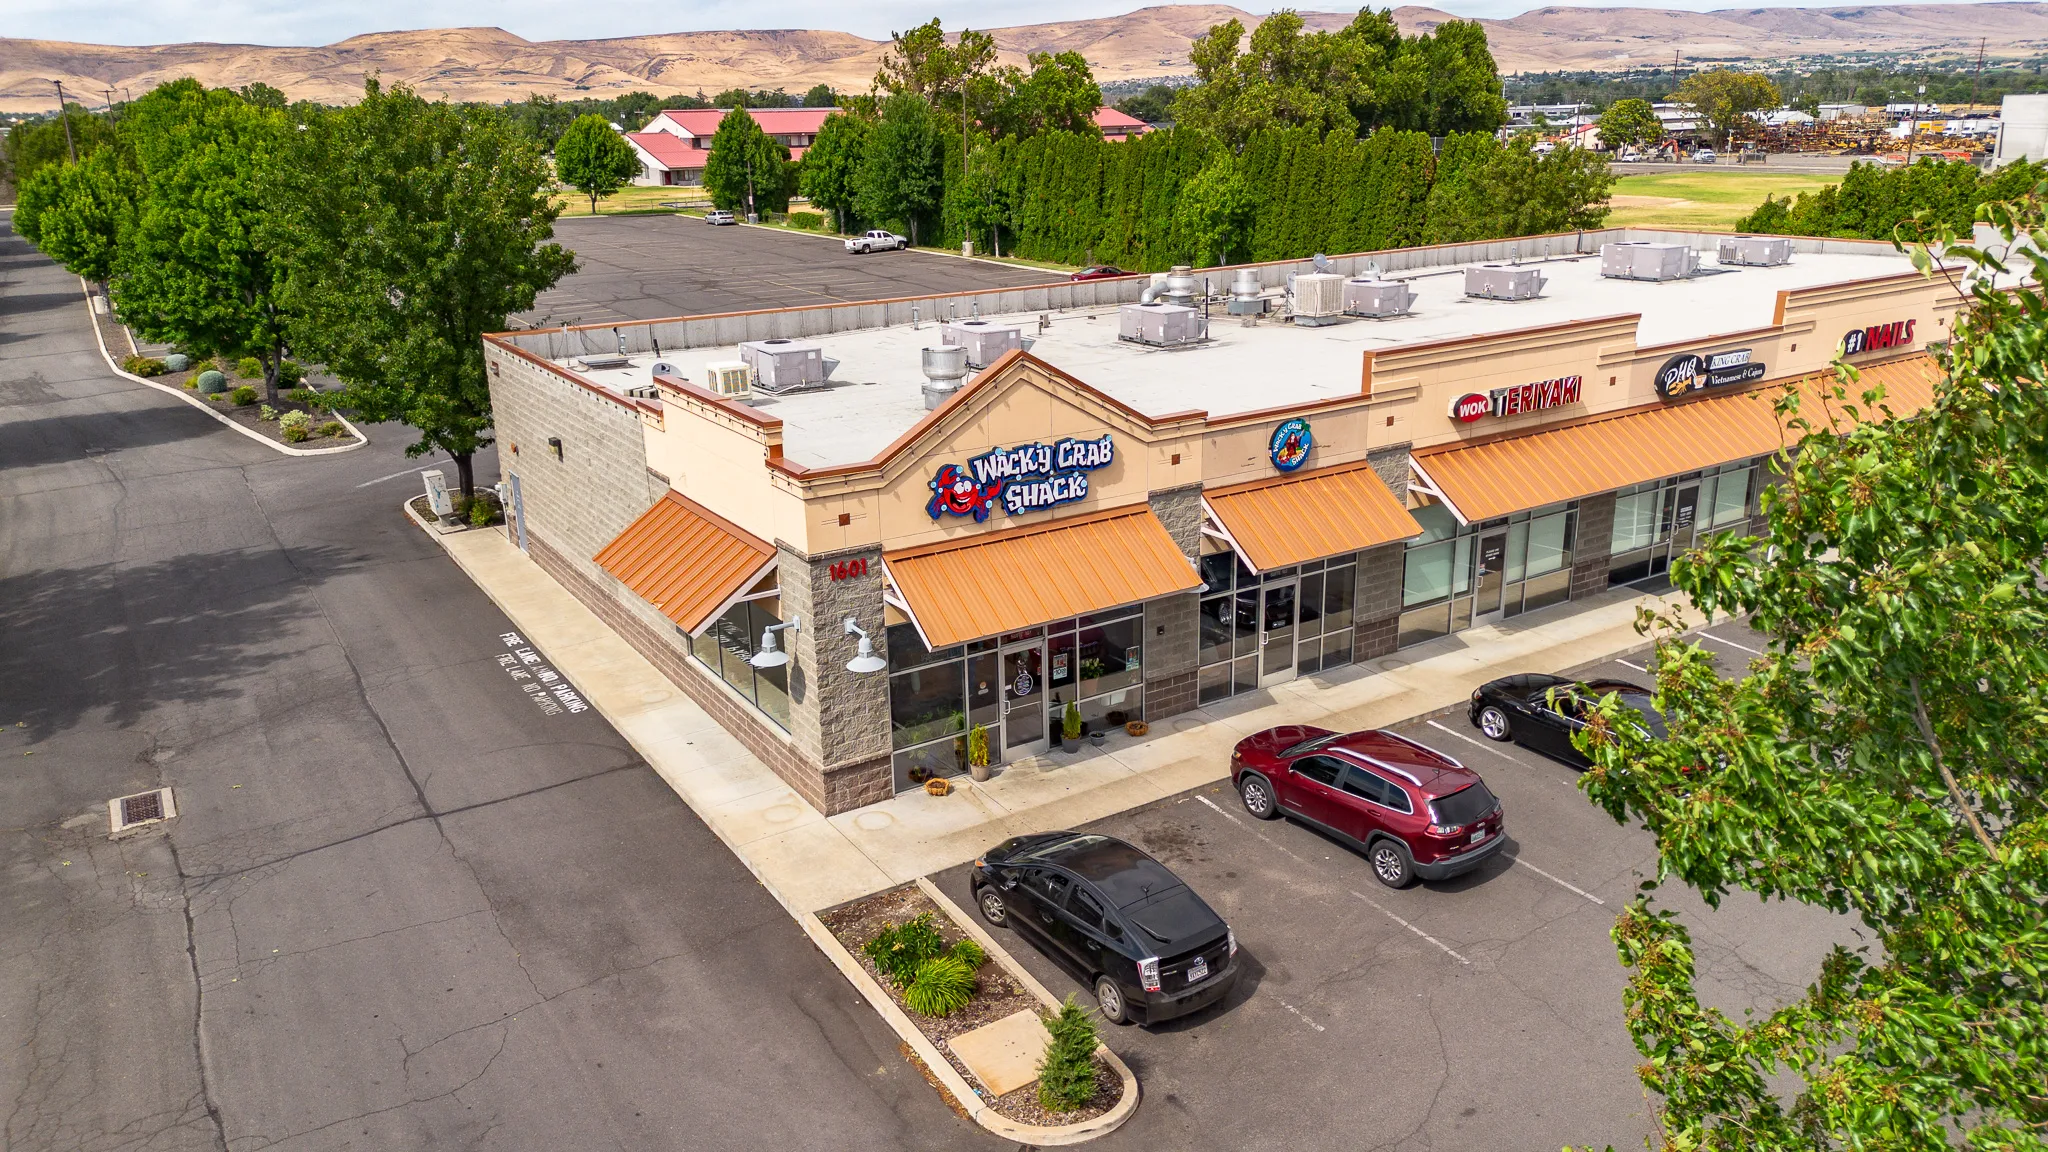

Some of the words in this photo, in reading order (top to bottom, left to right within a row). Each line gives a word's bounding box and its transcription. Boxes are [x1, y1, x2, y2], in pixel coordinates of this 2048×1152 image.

[1847, 332, 1863, 353] #1
[1865, 319, 1917, 352] NAILS
[1711, 356, 1730, 368] KING
[1731, 352, 1751, 364] CRAB
[1711, 374, 1742, 384] Vietnamese
[1742, 369, 1747, 379] &
[1748, 367, 1763, 378] Cajun
[1460, 401, 1487, 418] WOK
[1490, 375, 1583, 418] TERIYAKI
[1273, 427, 1288, 452] WACKY
[1287, 422, 1302, 430] CRAB
[973, 446, 1051, 484] WACKY
[1057, 439, 1112, 469] CRAB
[1291, 443, 1310, 466] SHACK
[1005, 475, 1088, 512] SHACK
[829, 557, 867, 582] 1601
[495, 653, 518, 667] FIRE
[499, 631, 524, 647] FIRE
[515, 647, 541, 666] LANE
[550, 683, 589, 713] PARKING
